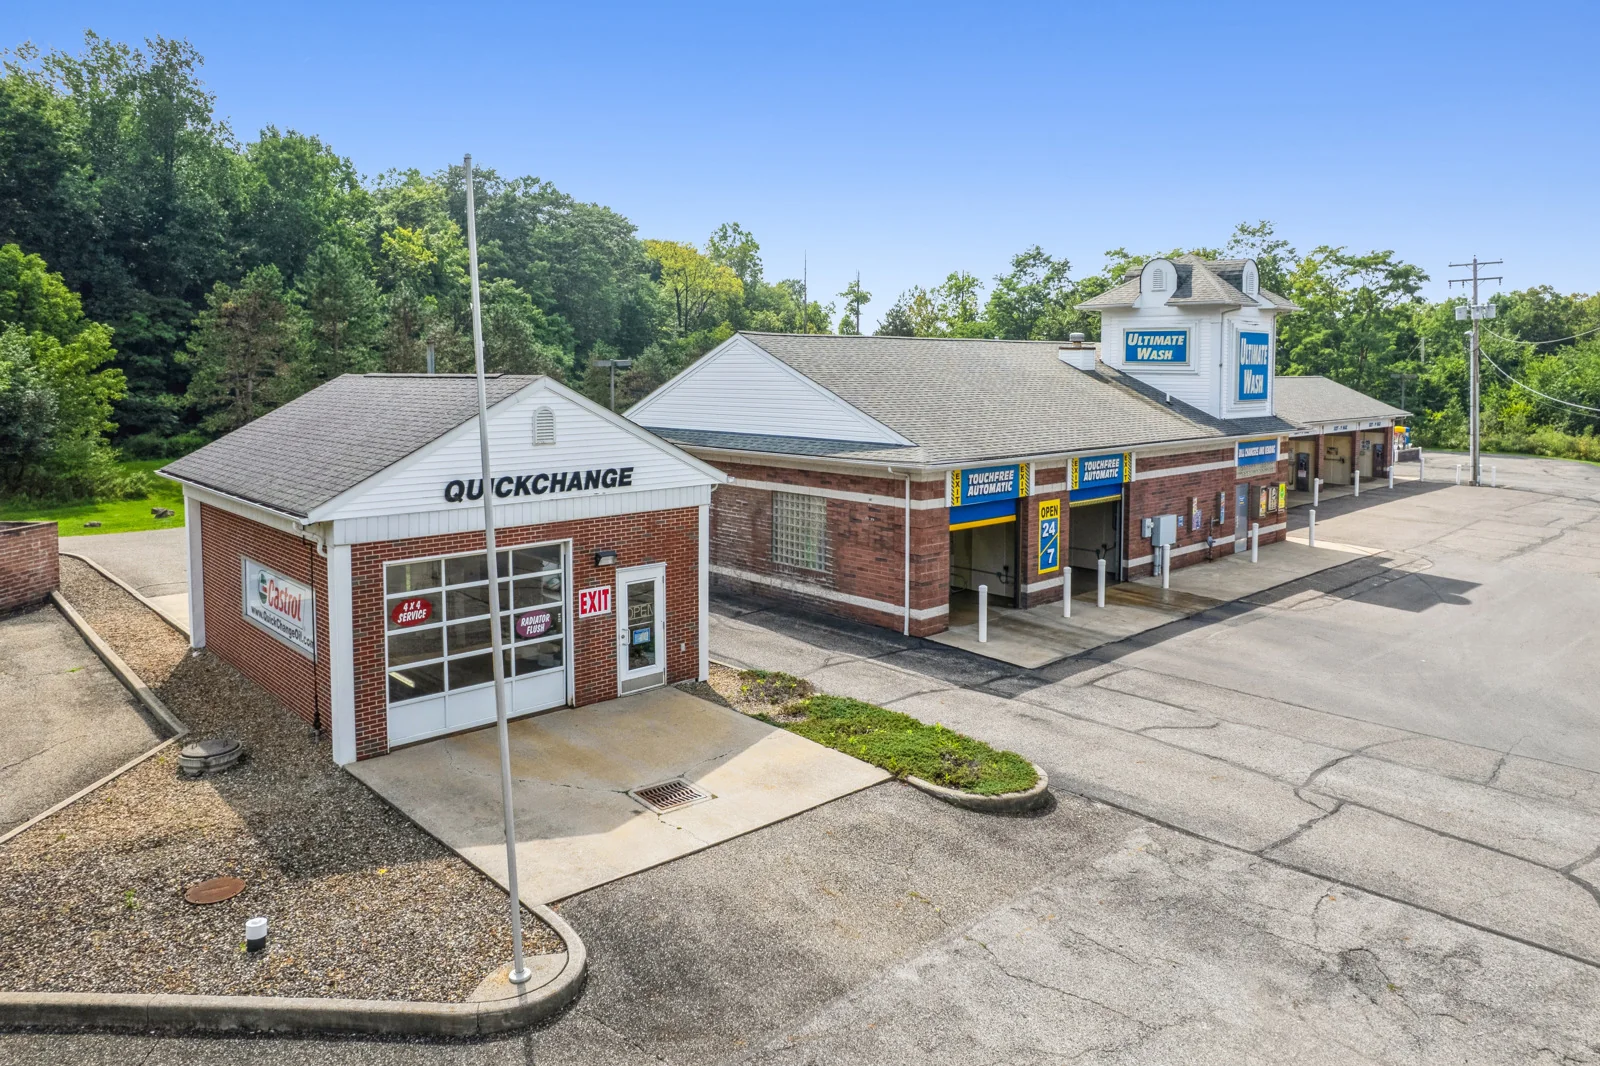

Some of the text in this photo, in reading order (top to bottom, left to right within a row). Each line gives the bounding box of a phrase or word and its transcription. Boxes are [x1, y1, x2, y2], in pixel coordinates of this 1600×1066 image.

[1127, 333, 1185, 346] ULTIMATE
[1137, 347, 1173, 360] WASH
[1240, 337, 1268, 366] ULTIMATE
[1243, 369, 1264, 394] WASH
[1084, 459, 1120, 471] TOUCHFREE
[968, 470, 1014, 485] TOUCHFREE
[1083, 468, 1119, 481] AUTOMATIC
[967, 481, 1013, 497] AUTOMATIC
[1040, 505, 1058, 518] OPEN
[1042, 521, 1056, 538] 24
[1047, 548, 1055, 564] 7
[267, 579, 302, 622] Castrol
[403, 602, 408, 612] 4
[416, 600, 421, 610] 4
[580, 588, 609, 615] EXIT
[397, 609, 427, 623] SERVICE
[520, 613, 550, 627] RADIATOR
[526, 623, 545, 635] FLUSH
